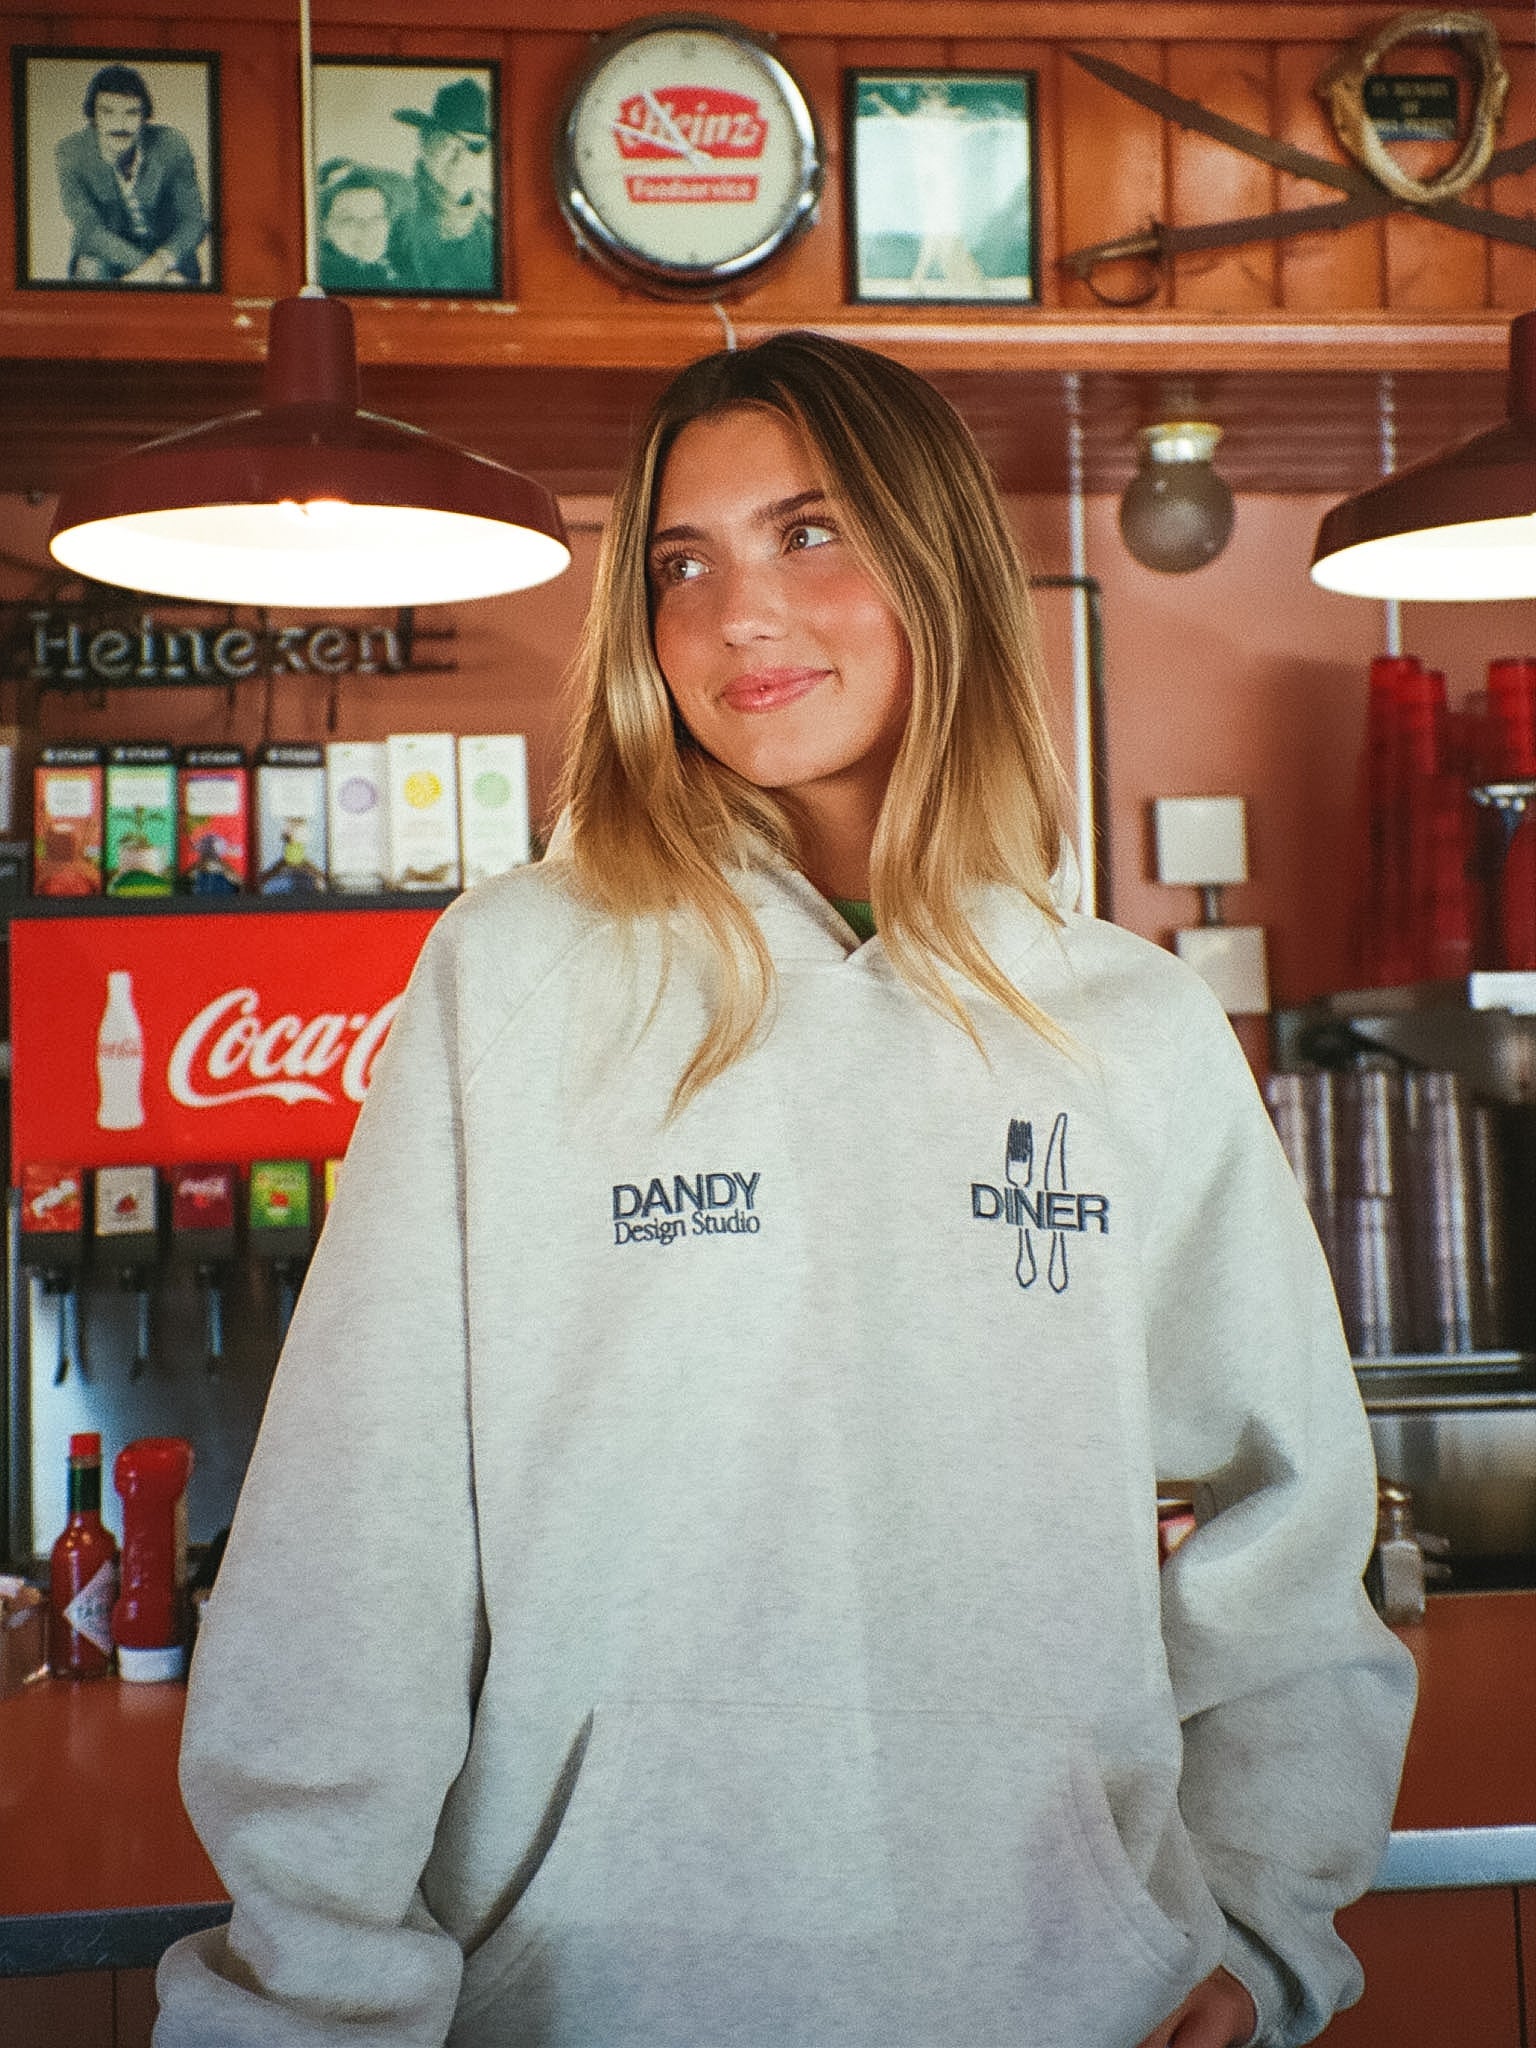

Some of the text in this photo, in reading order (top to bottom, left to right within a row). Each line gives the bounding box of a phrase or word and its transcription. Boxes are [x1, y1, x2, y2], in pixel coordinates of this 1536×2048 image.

[612, 1172, 761, 1221] DANDY
[970, 1183, 1111, 1235] DINER
[614, 1208, 760, 1246] Design Studio
